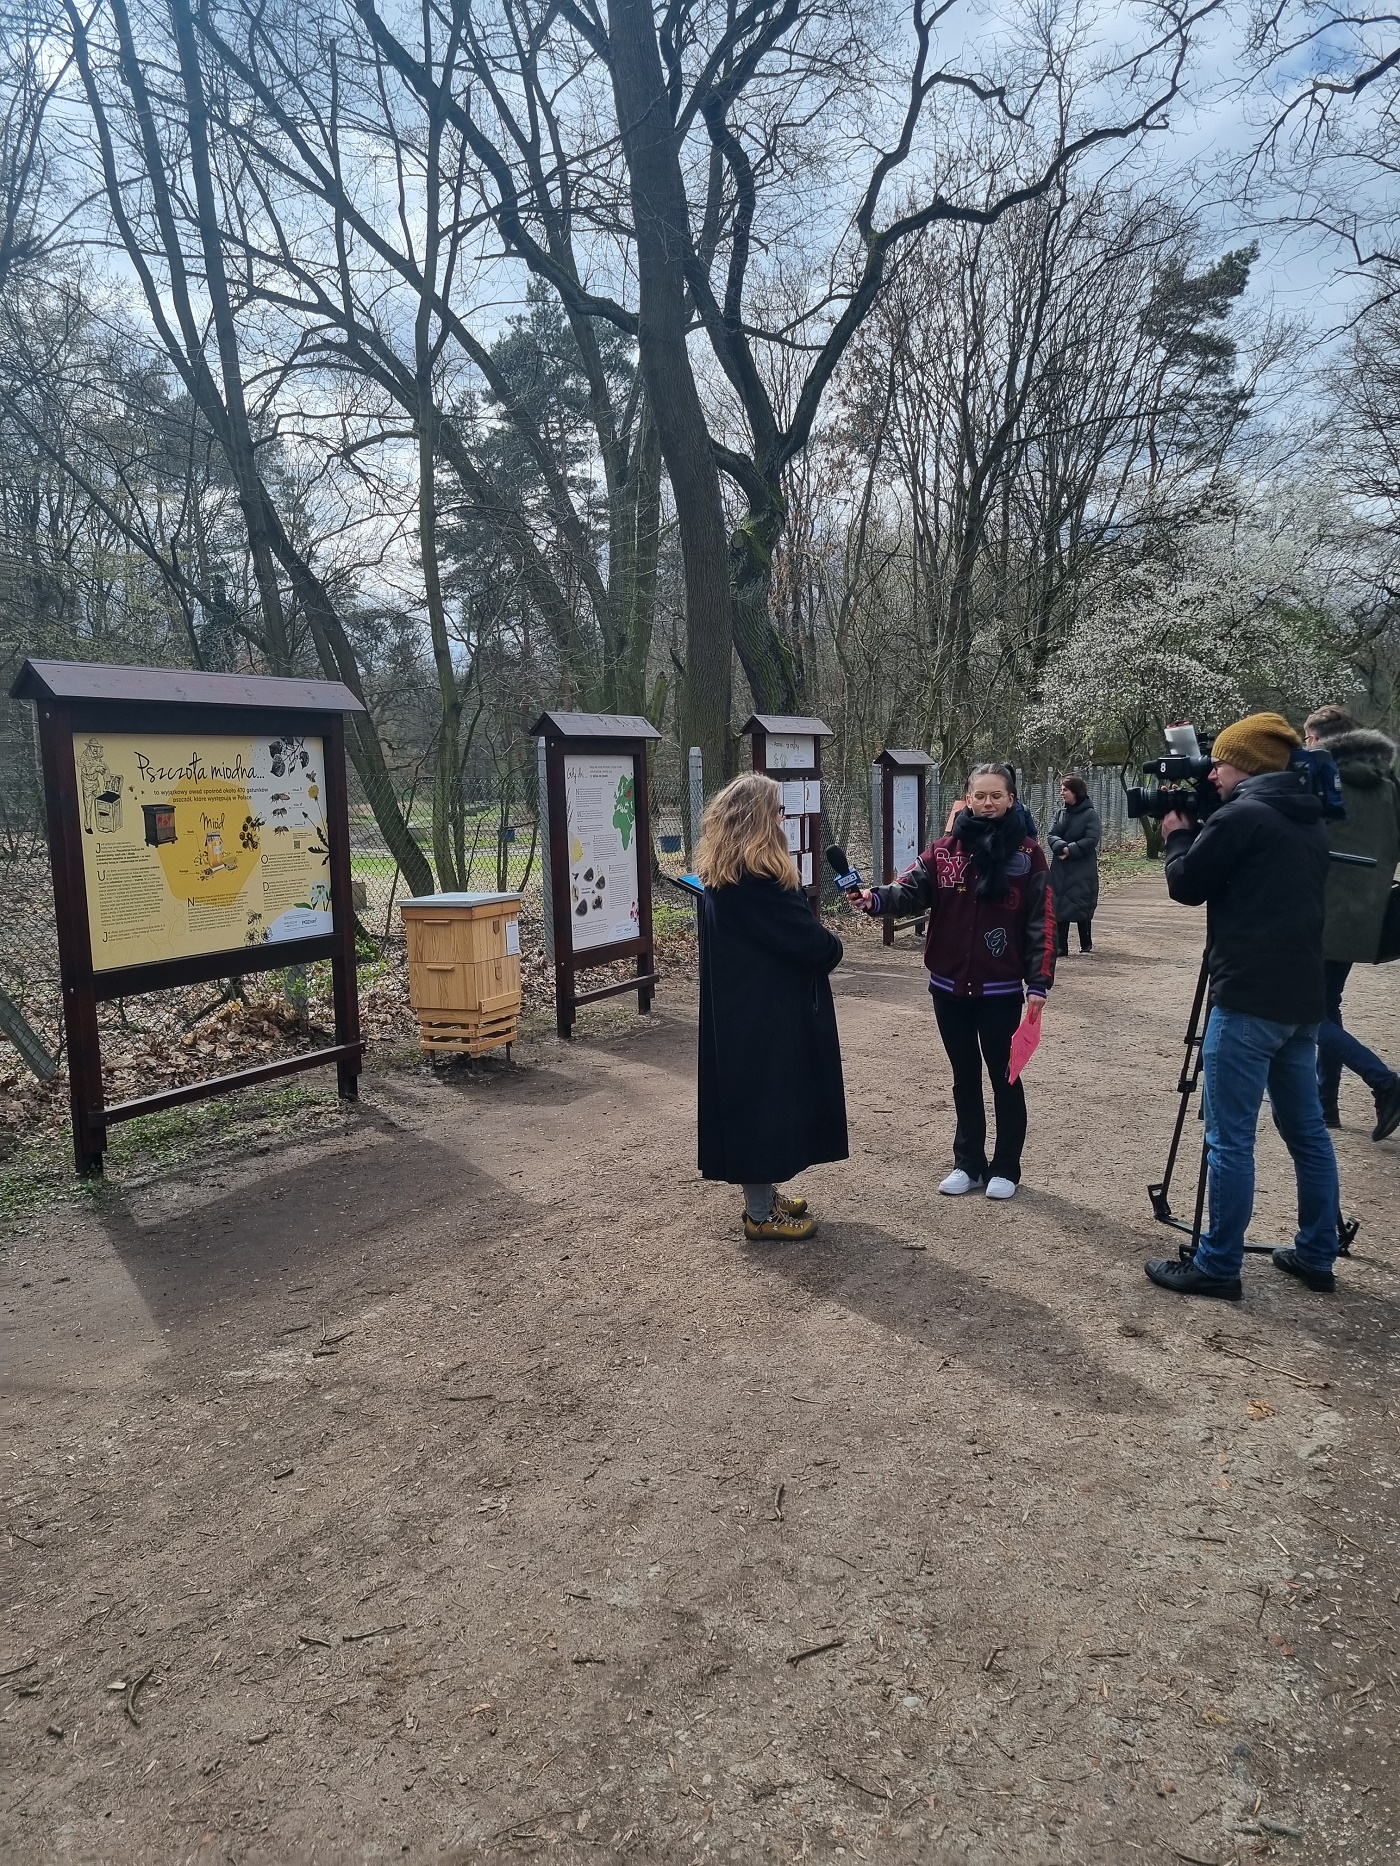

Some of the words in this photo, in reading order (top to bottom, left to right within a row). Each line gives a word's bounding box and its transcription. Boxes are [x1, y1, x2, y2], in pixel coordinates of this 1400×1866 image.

[133, 751, 207, 785] Pszczoła
[1160, 762, 1166, 772] 8
[199, 812, 225, 830] Miód
